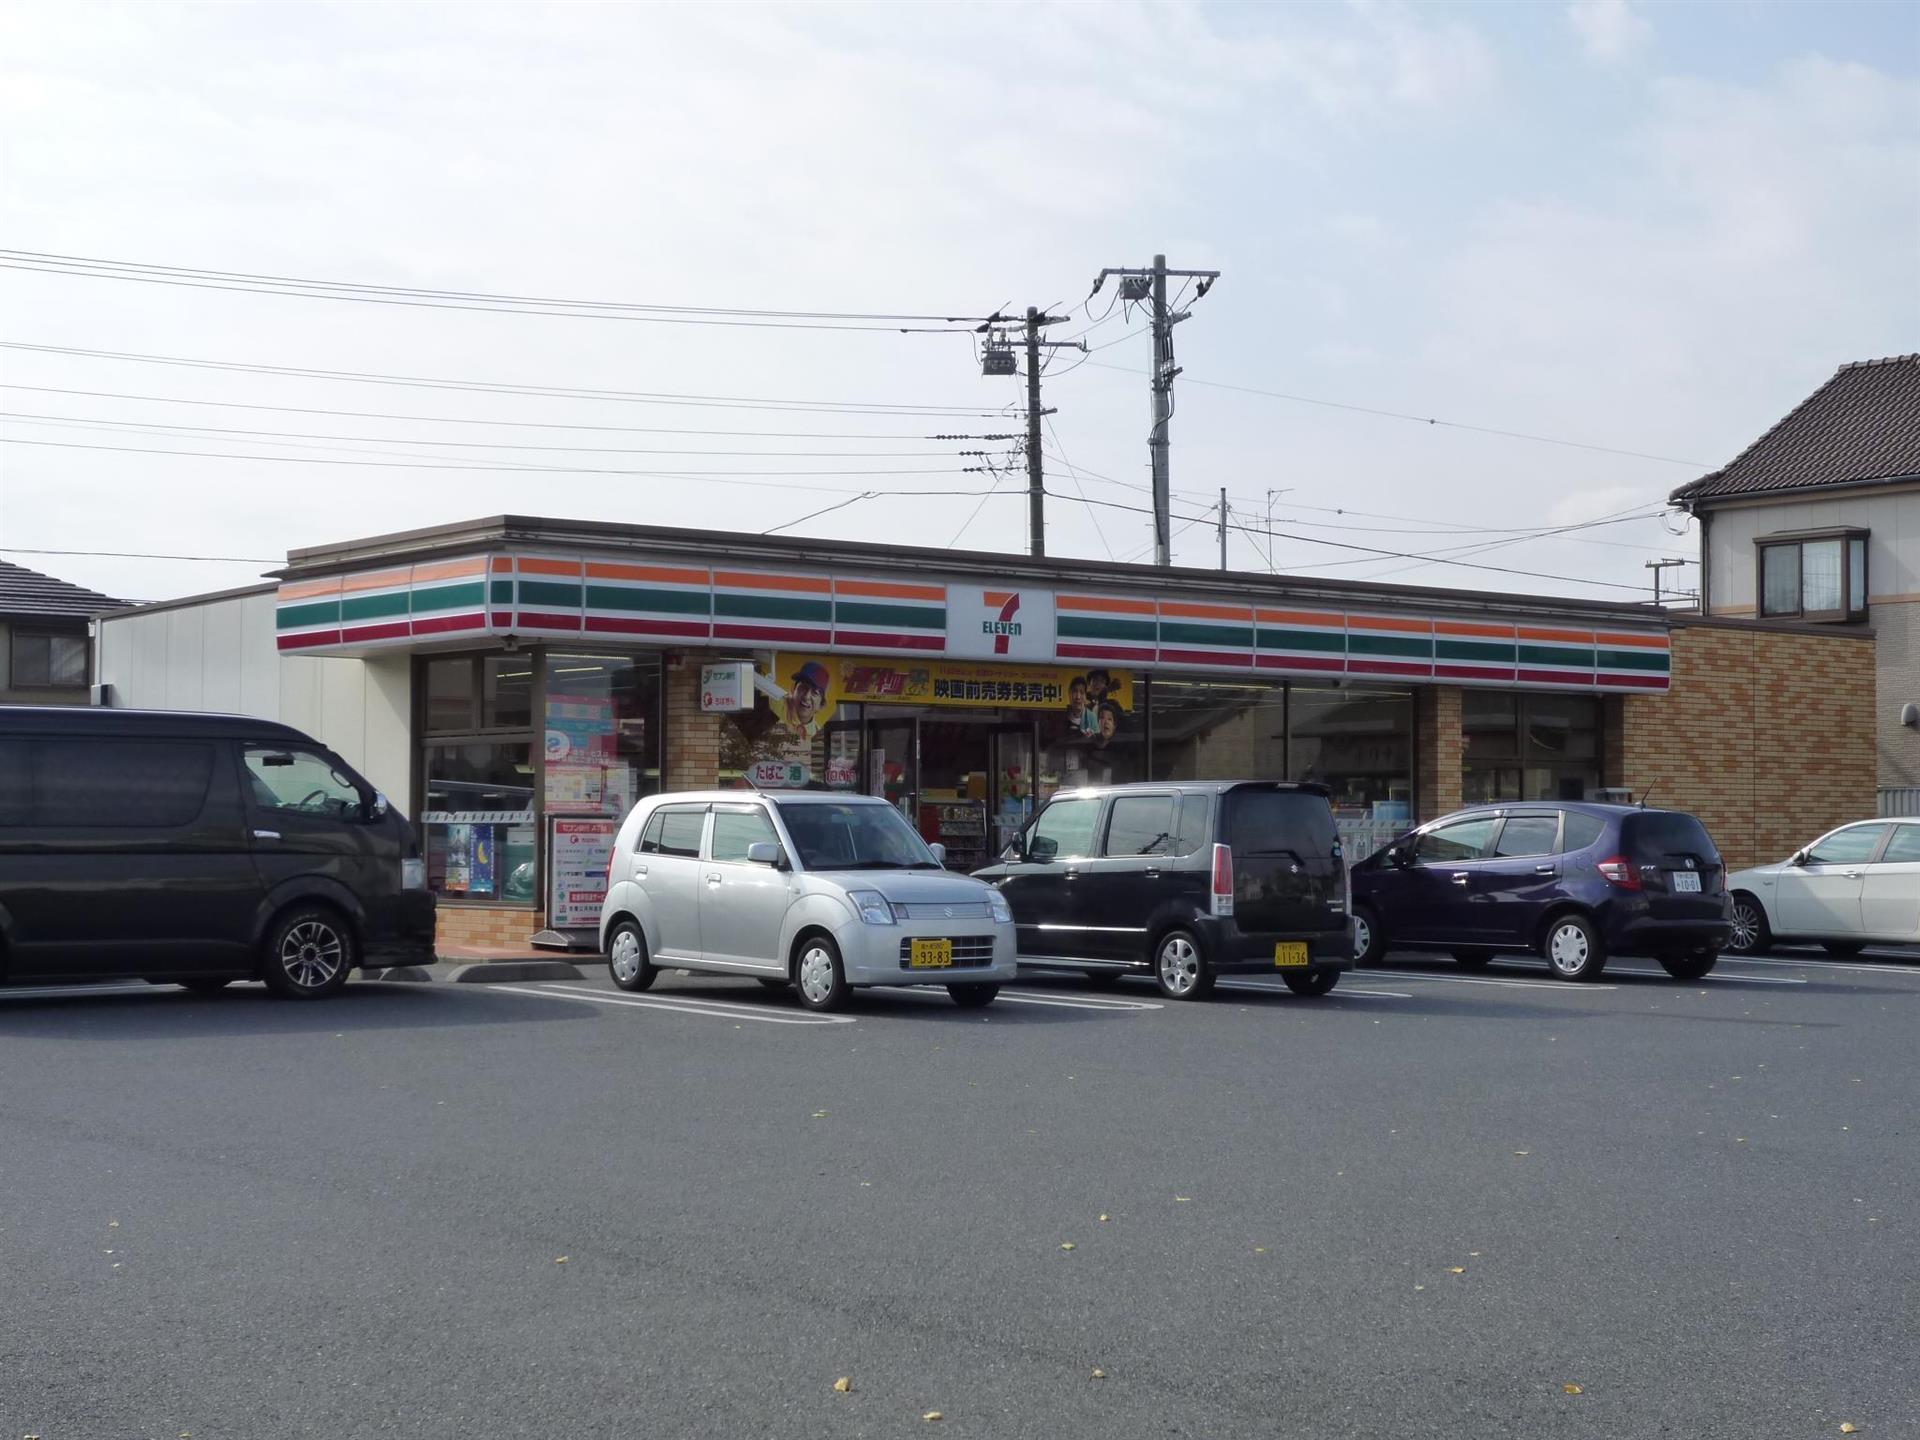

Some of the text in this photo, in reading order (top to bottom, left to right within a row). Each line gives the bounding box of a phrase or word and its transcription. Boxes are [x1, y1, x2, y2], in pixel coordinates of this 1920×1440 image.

[755, 765, 802, 781] たばこ 酒
[920, 951, 950, 964] 93-83
